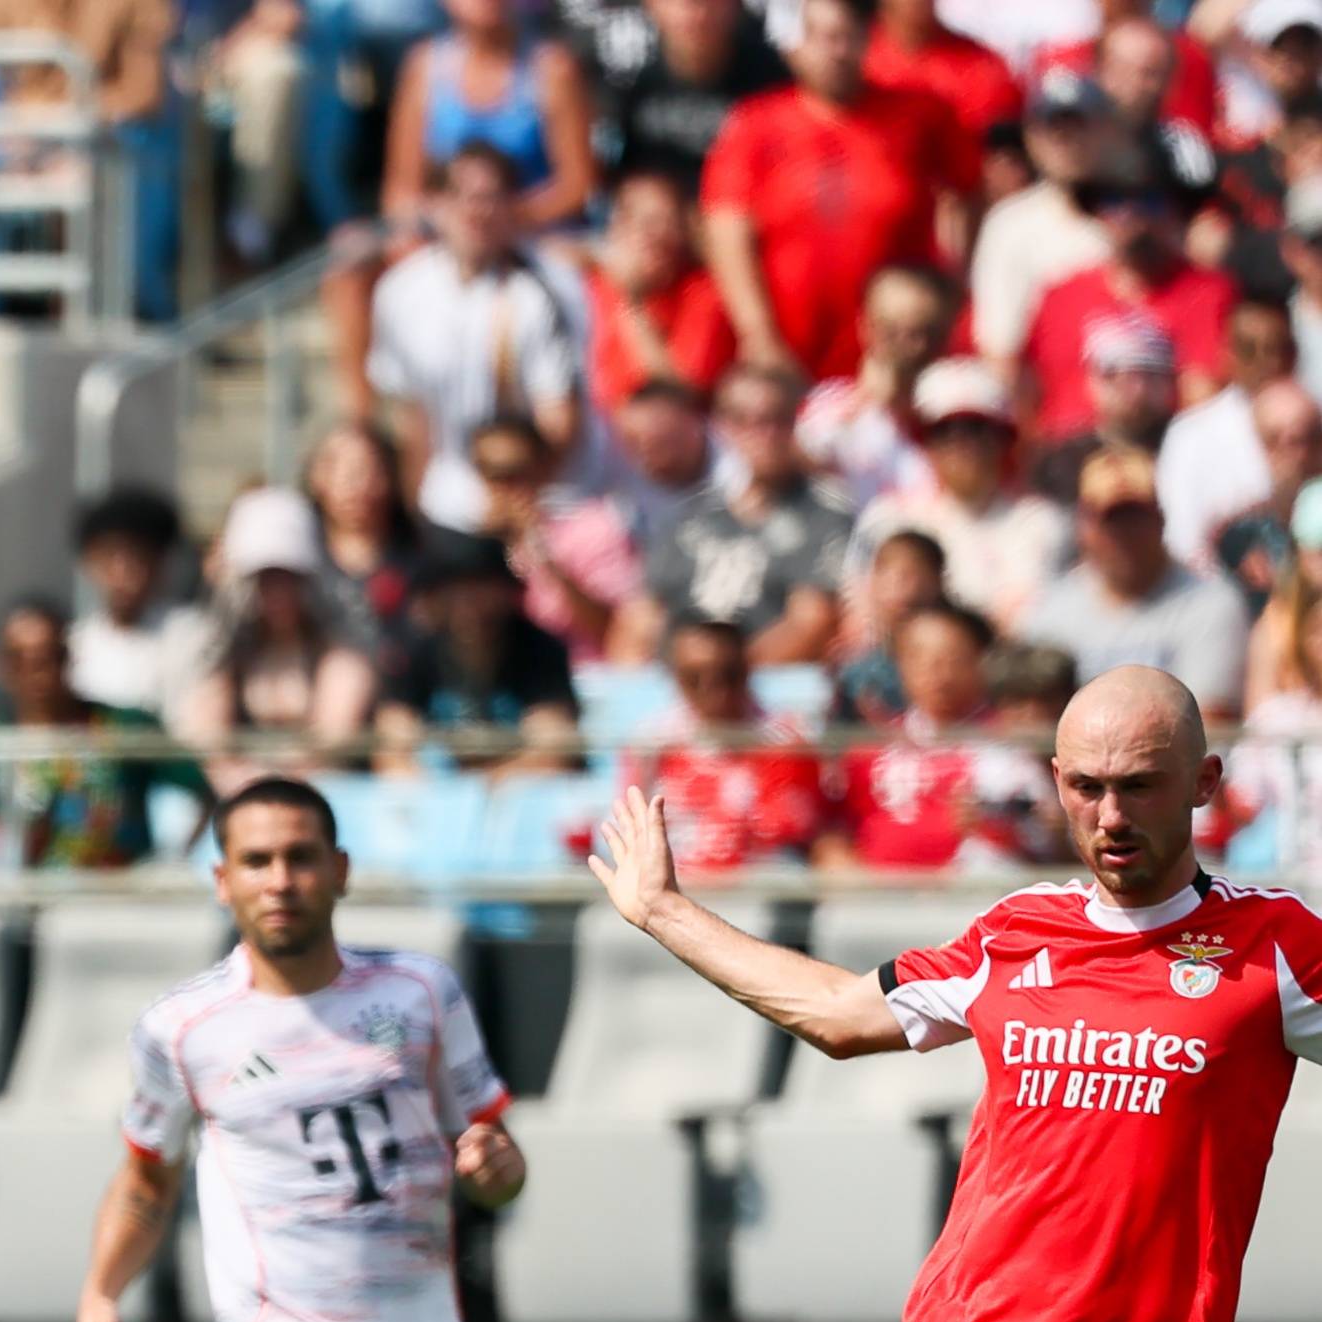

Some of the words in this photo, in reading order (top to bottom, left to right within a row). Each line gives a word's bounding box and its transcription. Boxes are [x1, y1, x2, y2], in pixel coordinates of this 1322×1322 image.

[1001, 1017, 1208, 1075] Emirates
[1015, 1068, 1059, 1109] FLY
[1062, 1071, 1168, 1116] BETTER
